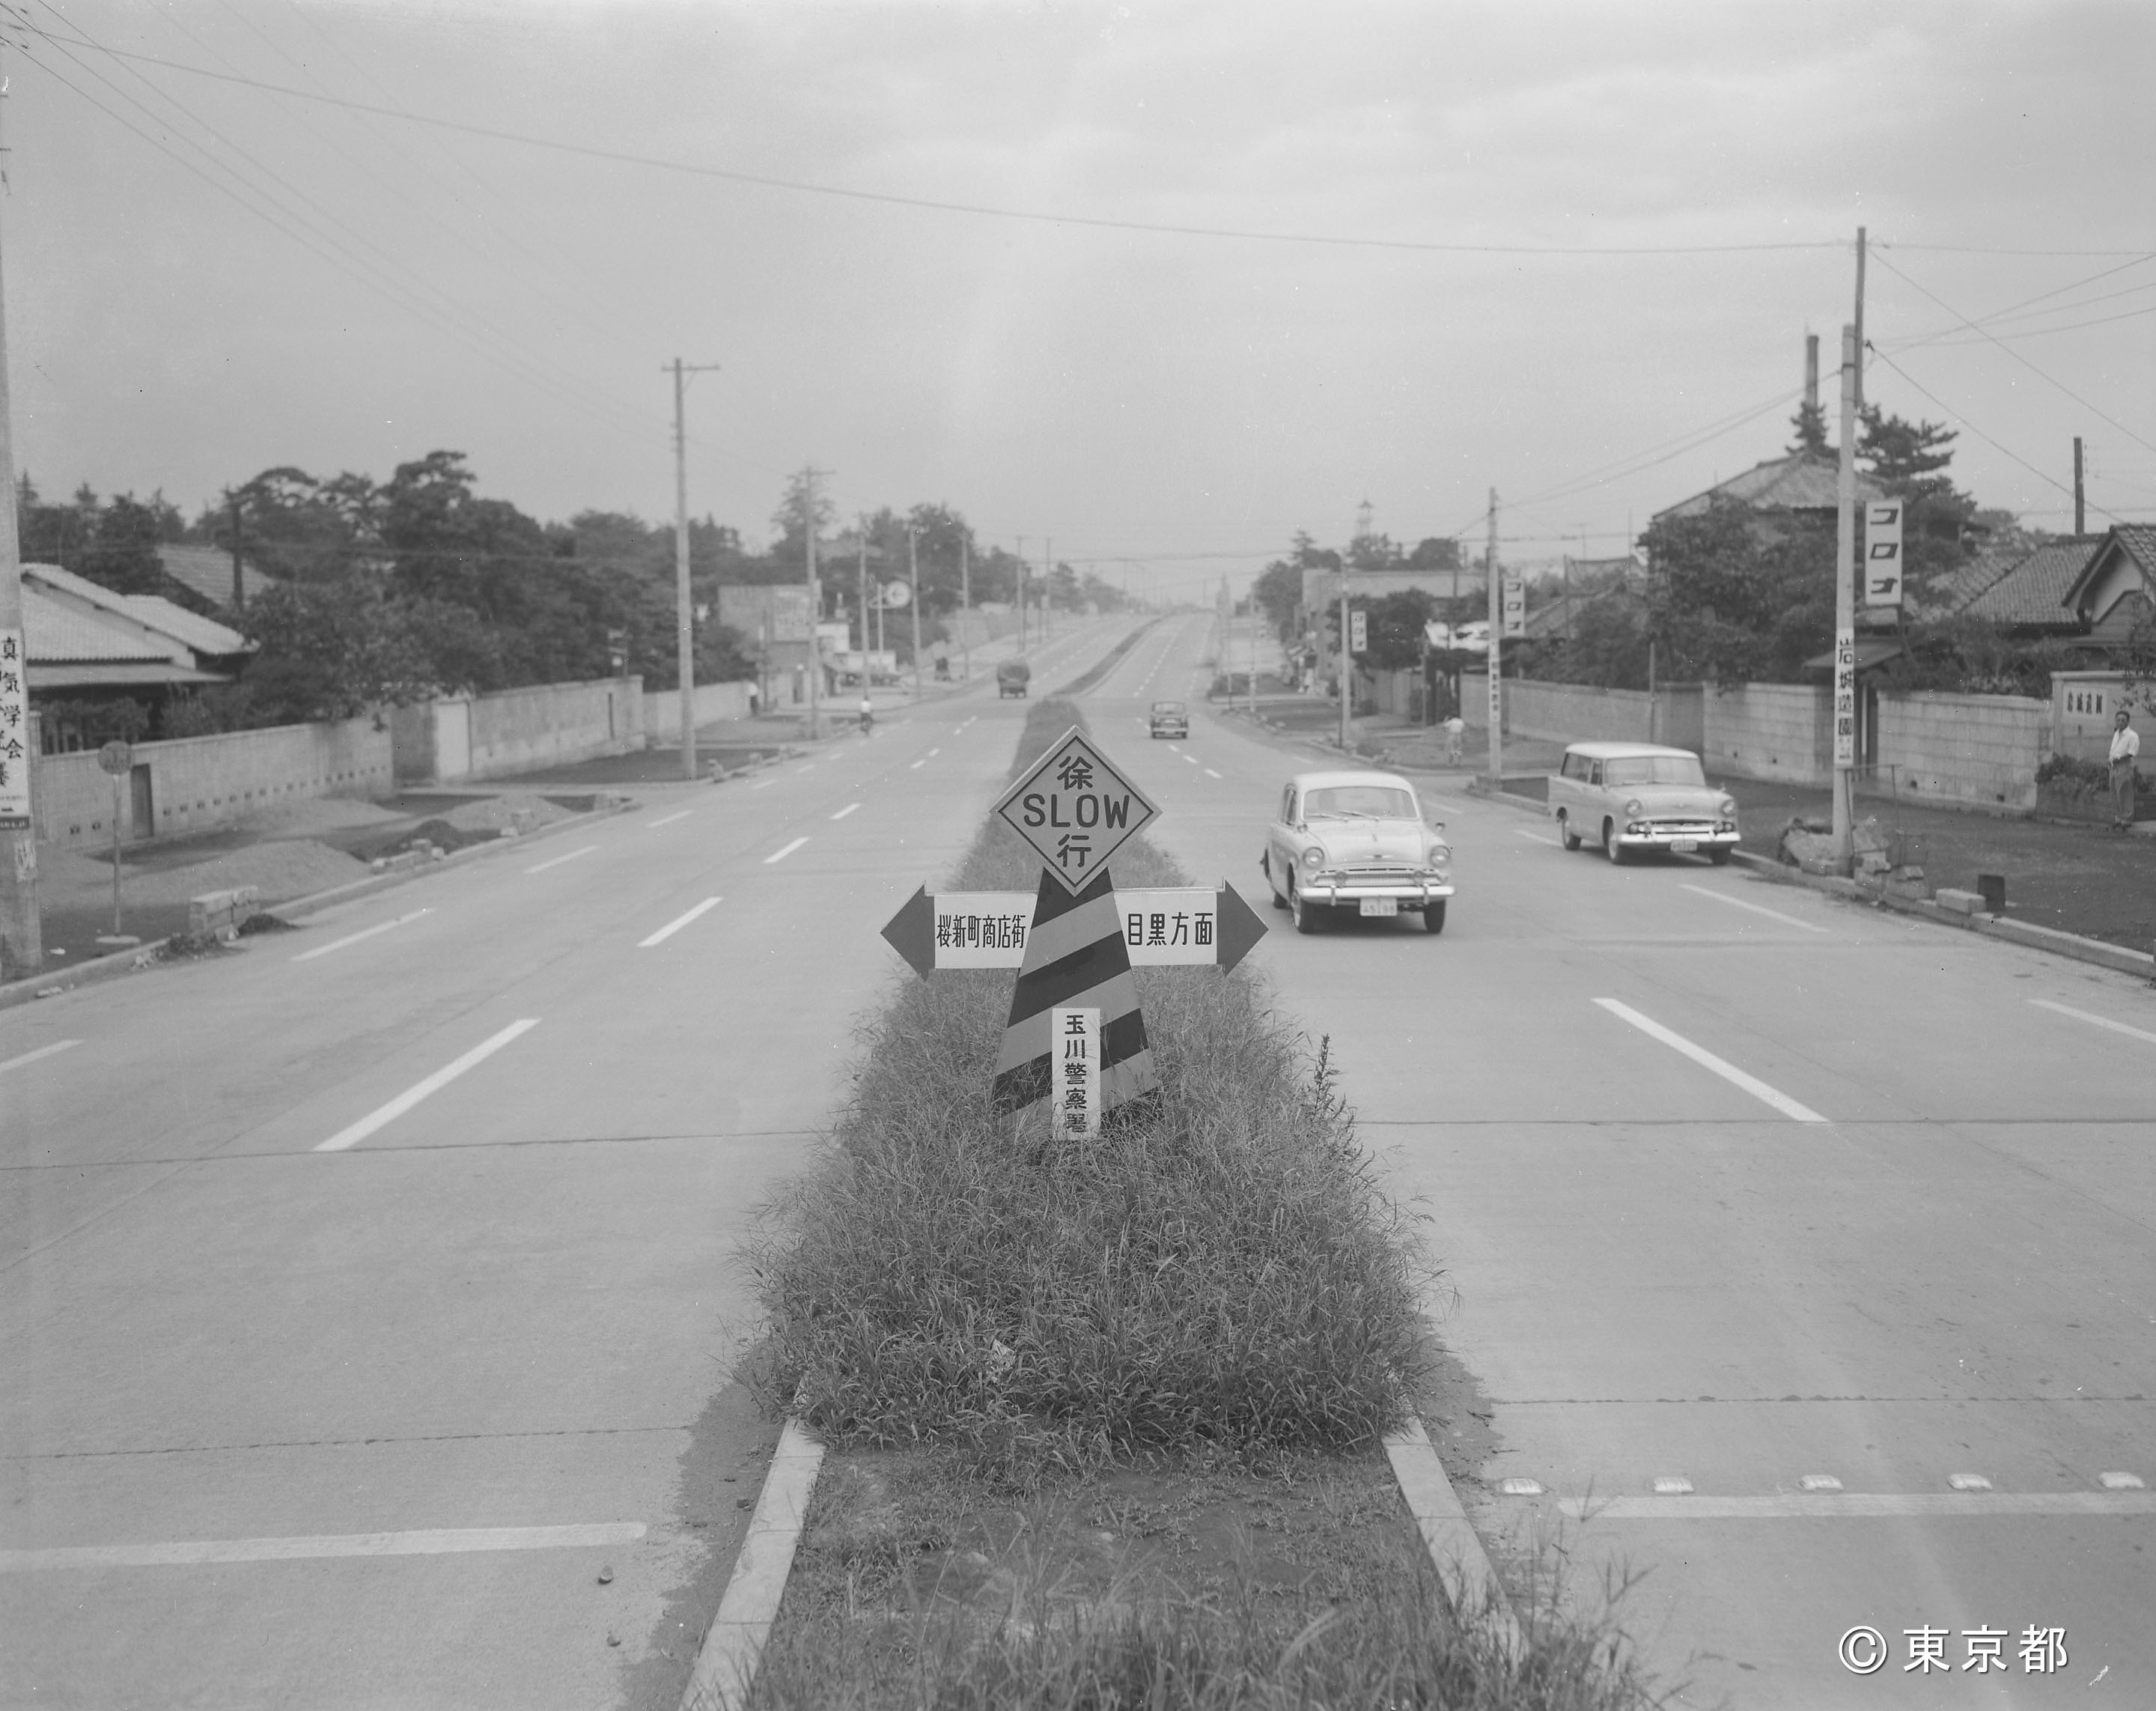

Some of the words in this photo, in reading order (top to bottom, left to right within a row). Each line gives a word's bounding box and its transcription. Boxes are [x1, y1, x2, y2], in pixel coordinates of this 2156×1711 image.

[1870, 508, 1898, 593] コロナ
[1057, 756, 1093, 790] 徐
[1023, 794, 1130, 829] SLOW
[1056, 833, 1091, 867] 行
[937, 914, 1026, 949] 桜新町商店街
[1127, 912, 1213, 946] 目黒方面
[1065, 1015, 1087, 1133] 玉川警察署
